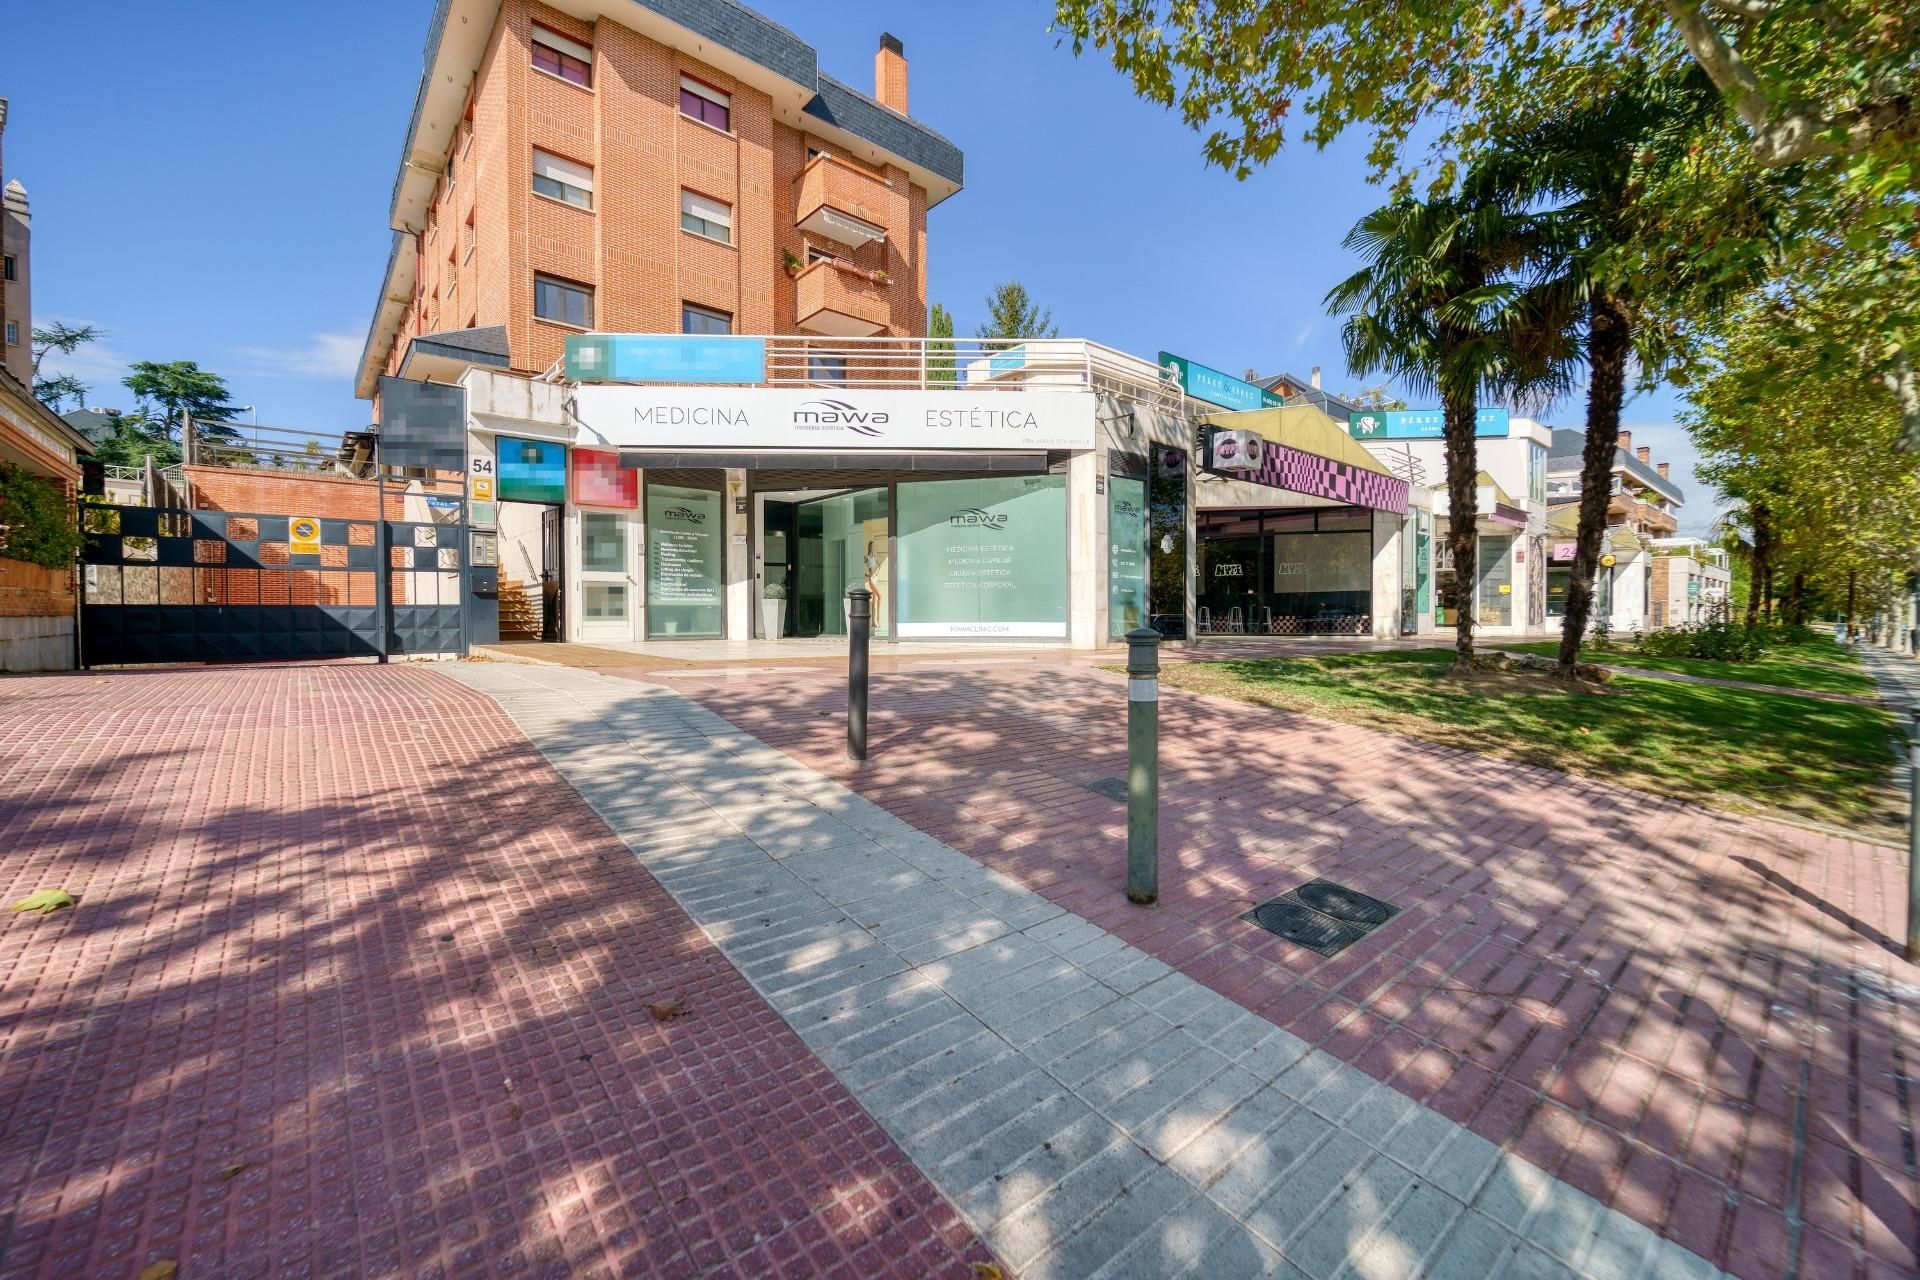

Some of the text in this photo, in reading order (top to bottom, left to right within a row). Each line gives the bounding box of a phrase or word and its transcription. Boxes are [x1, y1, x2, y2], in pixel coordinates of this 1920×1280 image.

[634, 406, 750, 427] MEDICINA
[793, 411, 889, 424] mawa
[926, 406, 1038, 429] ESTÉTICA
[473, 458, 493, 474] 54
[664, 510, 706, 519] mawa
[950, 514, 1008, 524] mawa
